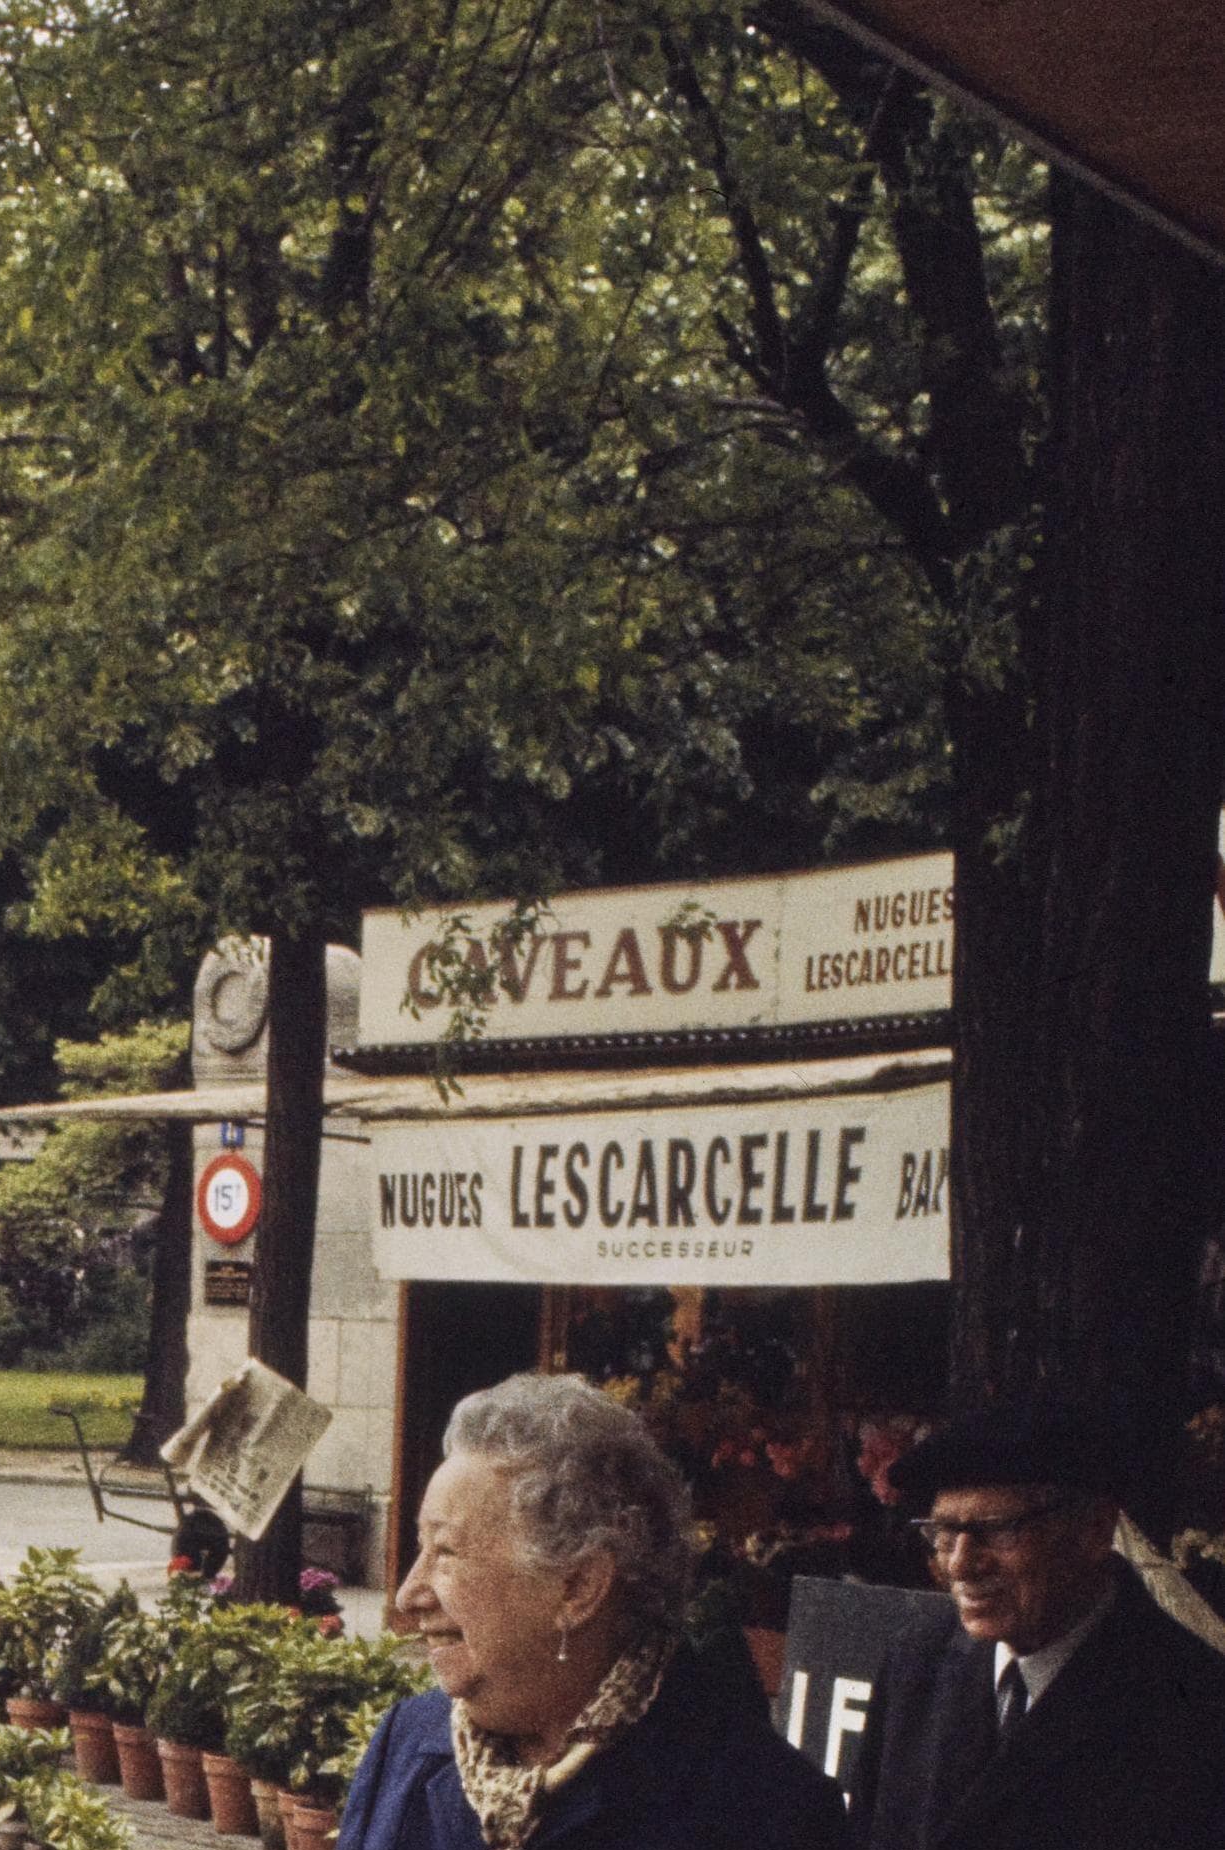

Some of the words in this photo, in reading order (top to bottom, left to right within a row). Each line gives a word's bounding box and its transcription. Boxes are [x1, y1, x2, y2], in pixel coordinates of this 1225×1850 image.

[855, 886, 954, 933] NUGUES
[378, 1170, 484, 1229] NUGUES
[511, 1125, 867, 1230] LESCARCELLE
[596, 1238, 757, 1260] SUCCESSEUR
